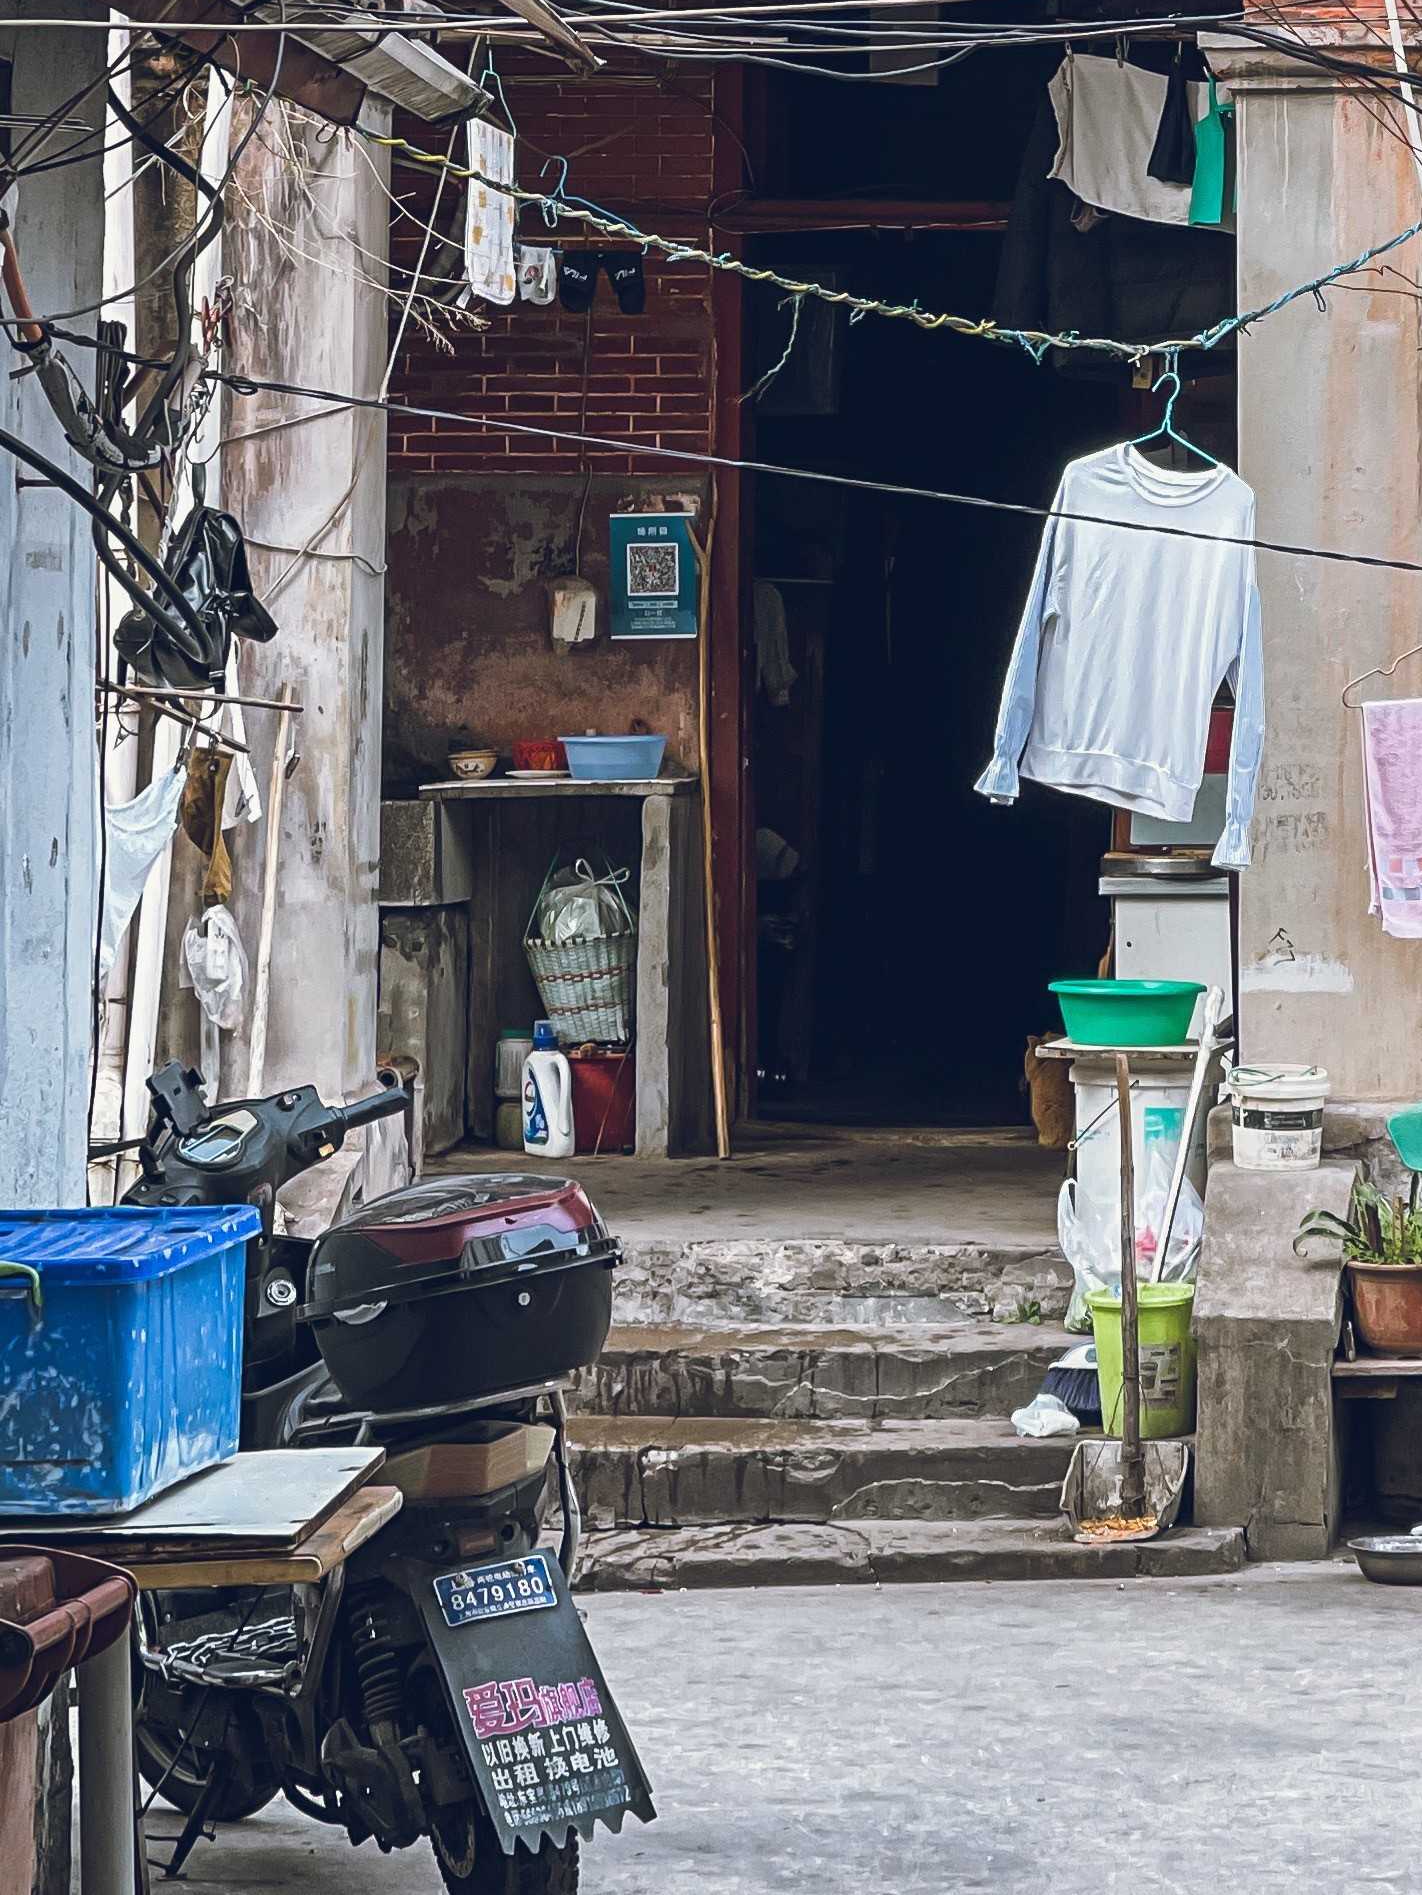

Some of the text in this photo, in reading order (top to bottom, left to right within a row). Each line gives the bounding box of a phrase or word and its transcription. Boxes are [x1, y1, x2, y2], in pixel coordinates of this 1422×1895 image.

[451, 1576, 544, 1610] 8479180
[481, 1718, 611, 1767] 以旧换新 上门维修
[491, 1762, 540, 1791] 出租
[543, 1746, 619, 1781] 换电池
